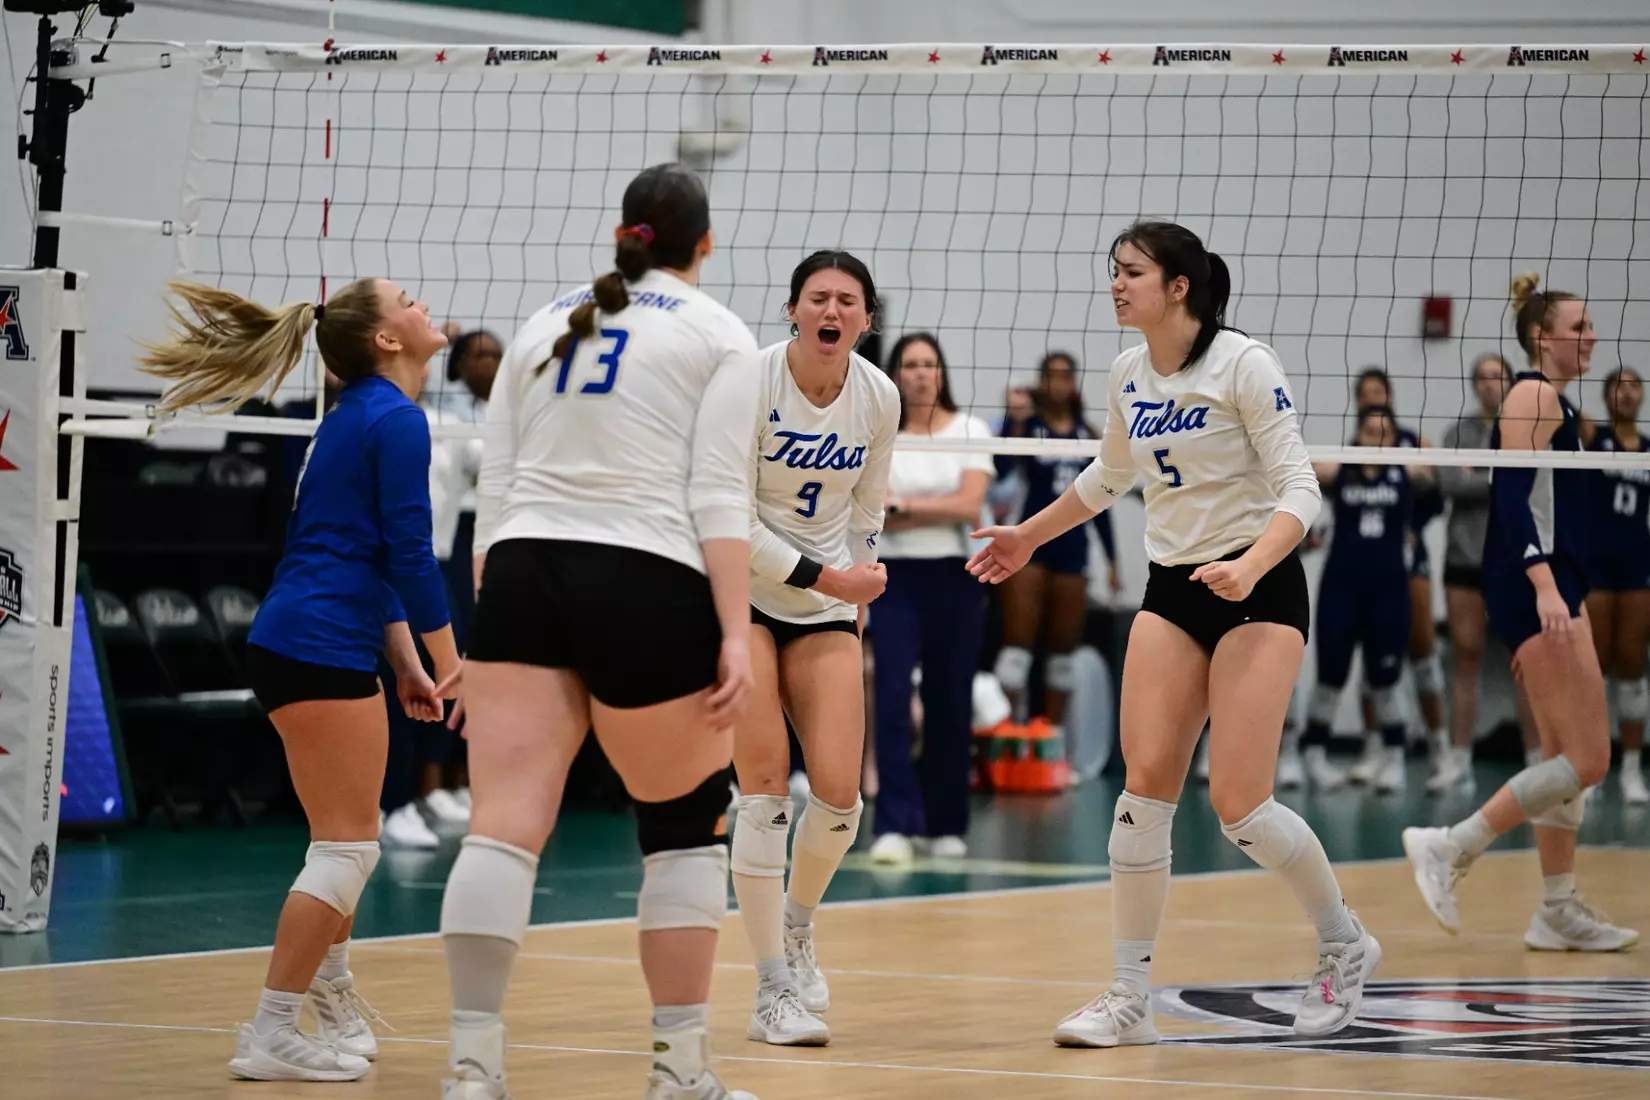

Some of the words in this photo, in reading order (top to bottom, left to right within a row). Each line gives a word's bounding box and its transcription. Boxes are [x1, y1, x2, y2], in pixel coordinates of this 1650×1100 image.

[485, 47, 558, 66] AMERICAN
[647, 46, 721, 66] AMERICAN
[812, 47, 888, 66] AMERICAN
[981, 45, 1058, 66] AMERICAN
[1152, 46, 1231, 66] AMERICAN
[1327, 46, 1409, 66] AMERICAN
[1507, 46, 1590, 66] AMERICAN
[555, 327, 630, 394] 13
[1128, 399, 1210, 440] Tulsa
[764, 430, 866, 471] Tulsa
[1153, 447, 1183, 488] 5
[794, 481, 823, 519] 9
[47, 664, 59, 733] sports
[42, 737, 53, 822] imports
